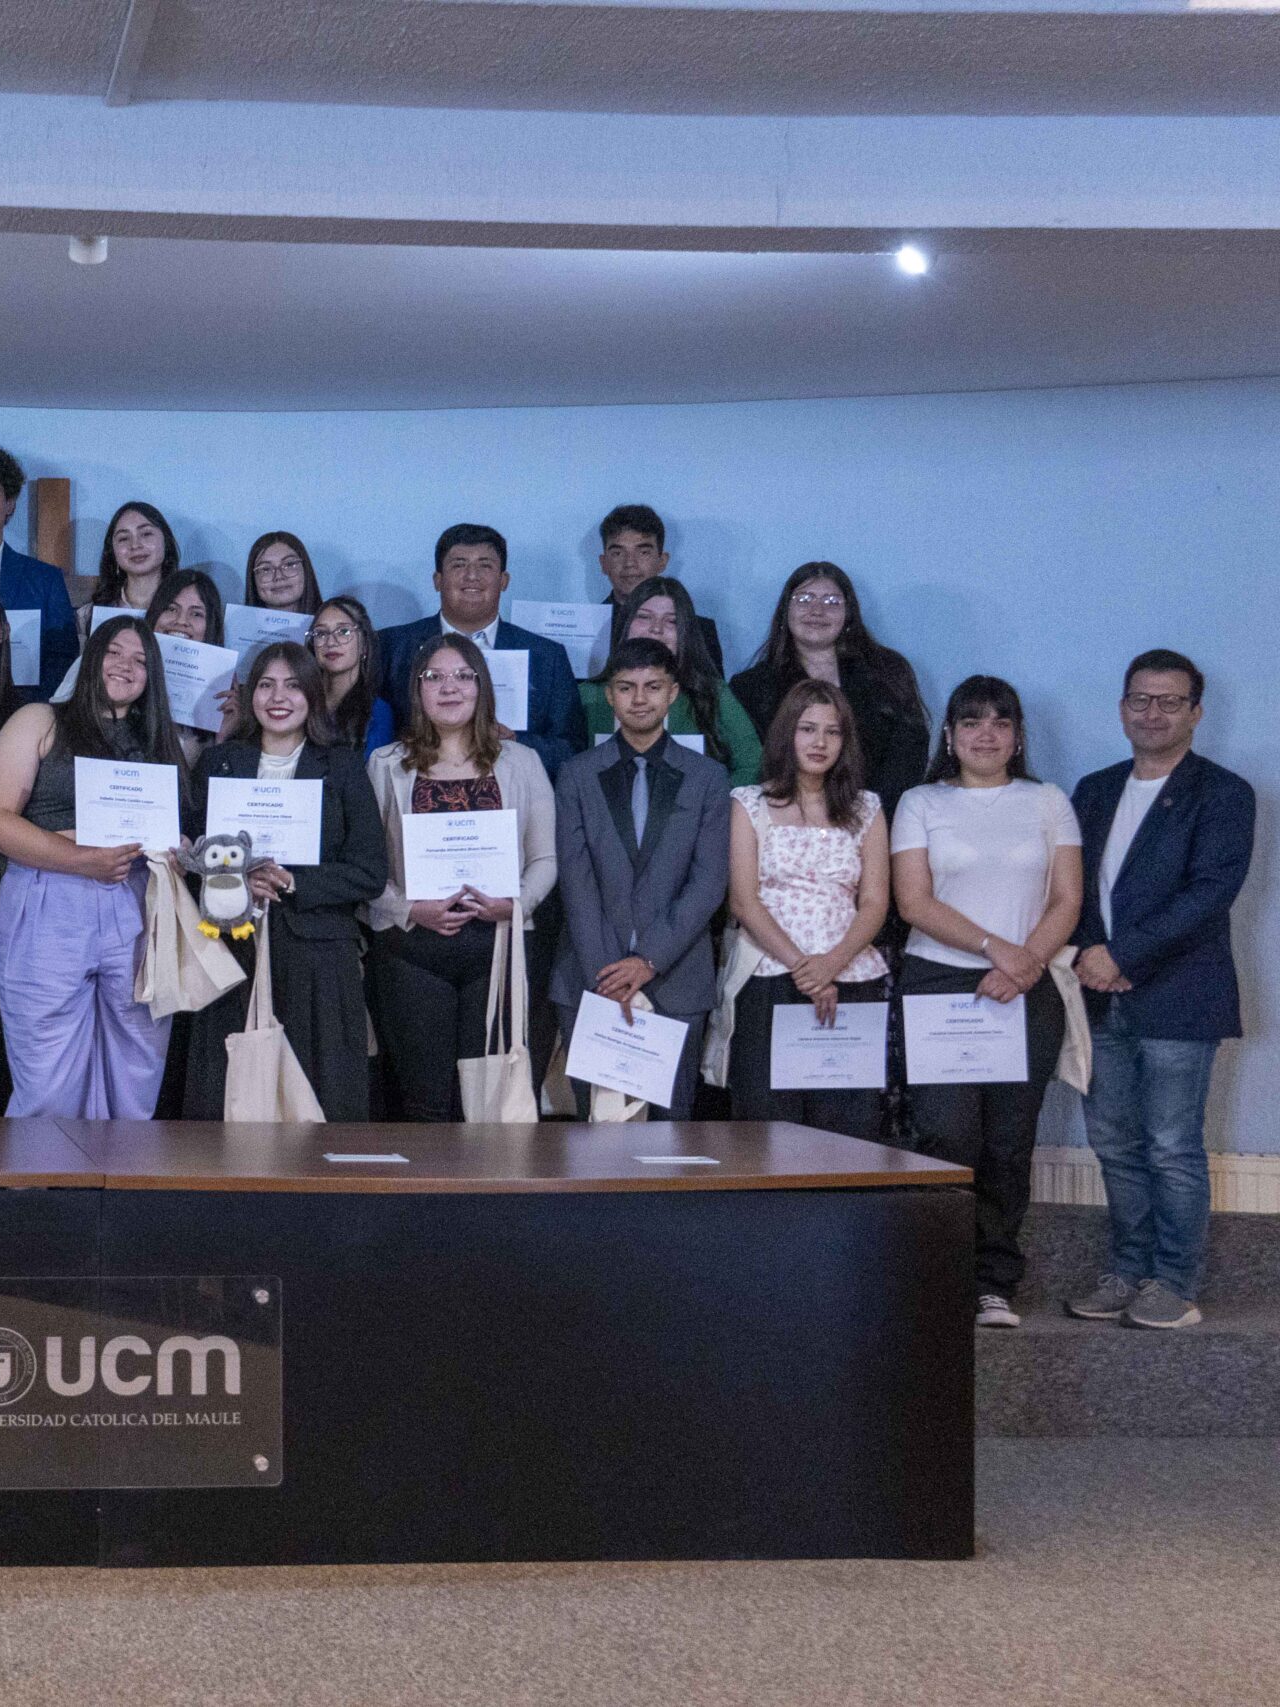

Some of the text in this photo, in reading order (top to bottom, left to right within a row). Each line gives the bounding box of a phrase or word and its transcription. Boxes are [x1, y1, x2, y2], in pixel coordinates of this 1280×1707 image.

[165, 659, 199, 670] CERTIFICADO
[70, 1414, 148, 1426] CATOLICA
[152, 1413, 182, 1426] DEL
[186, 1412, 241, 1424] MAULE
